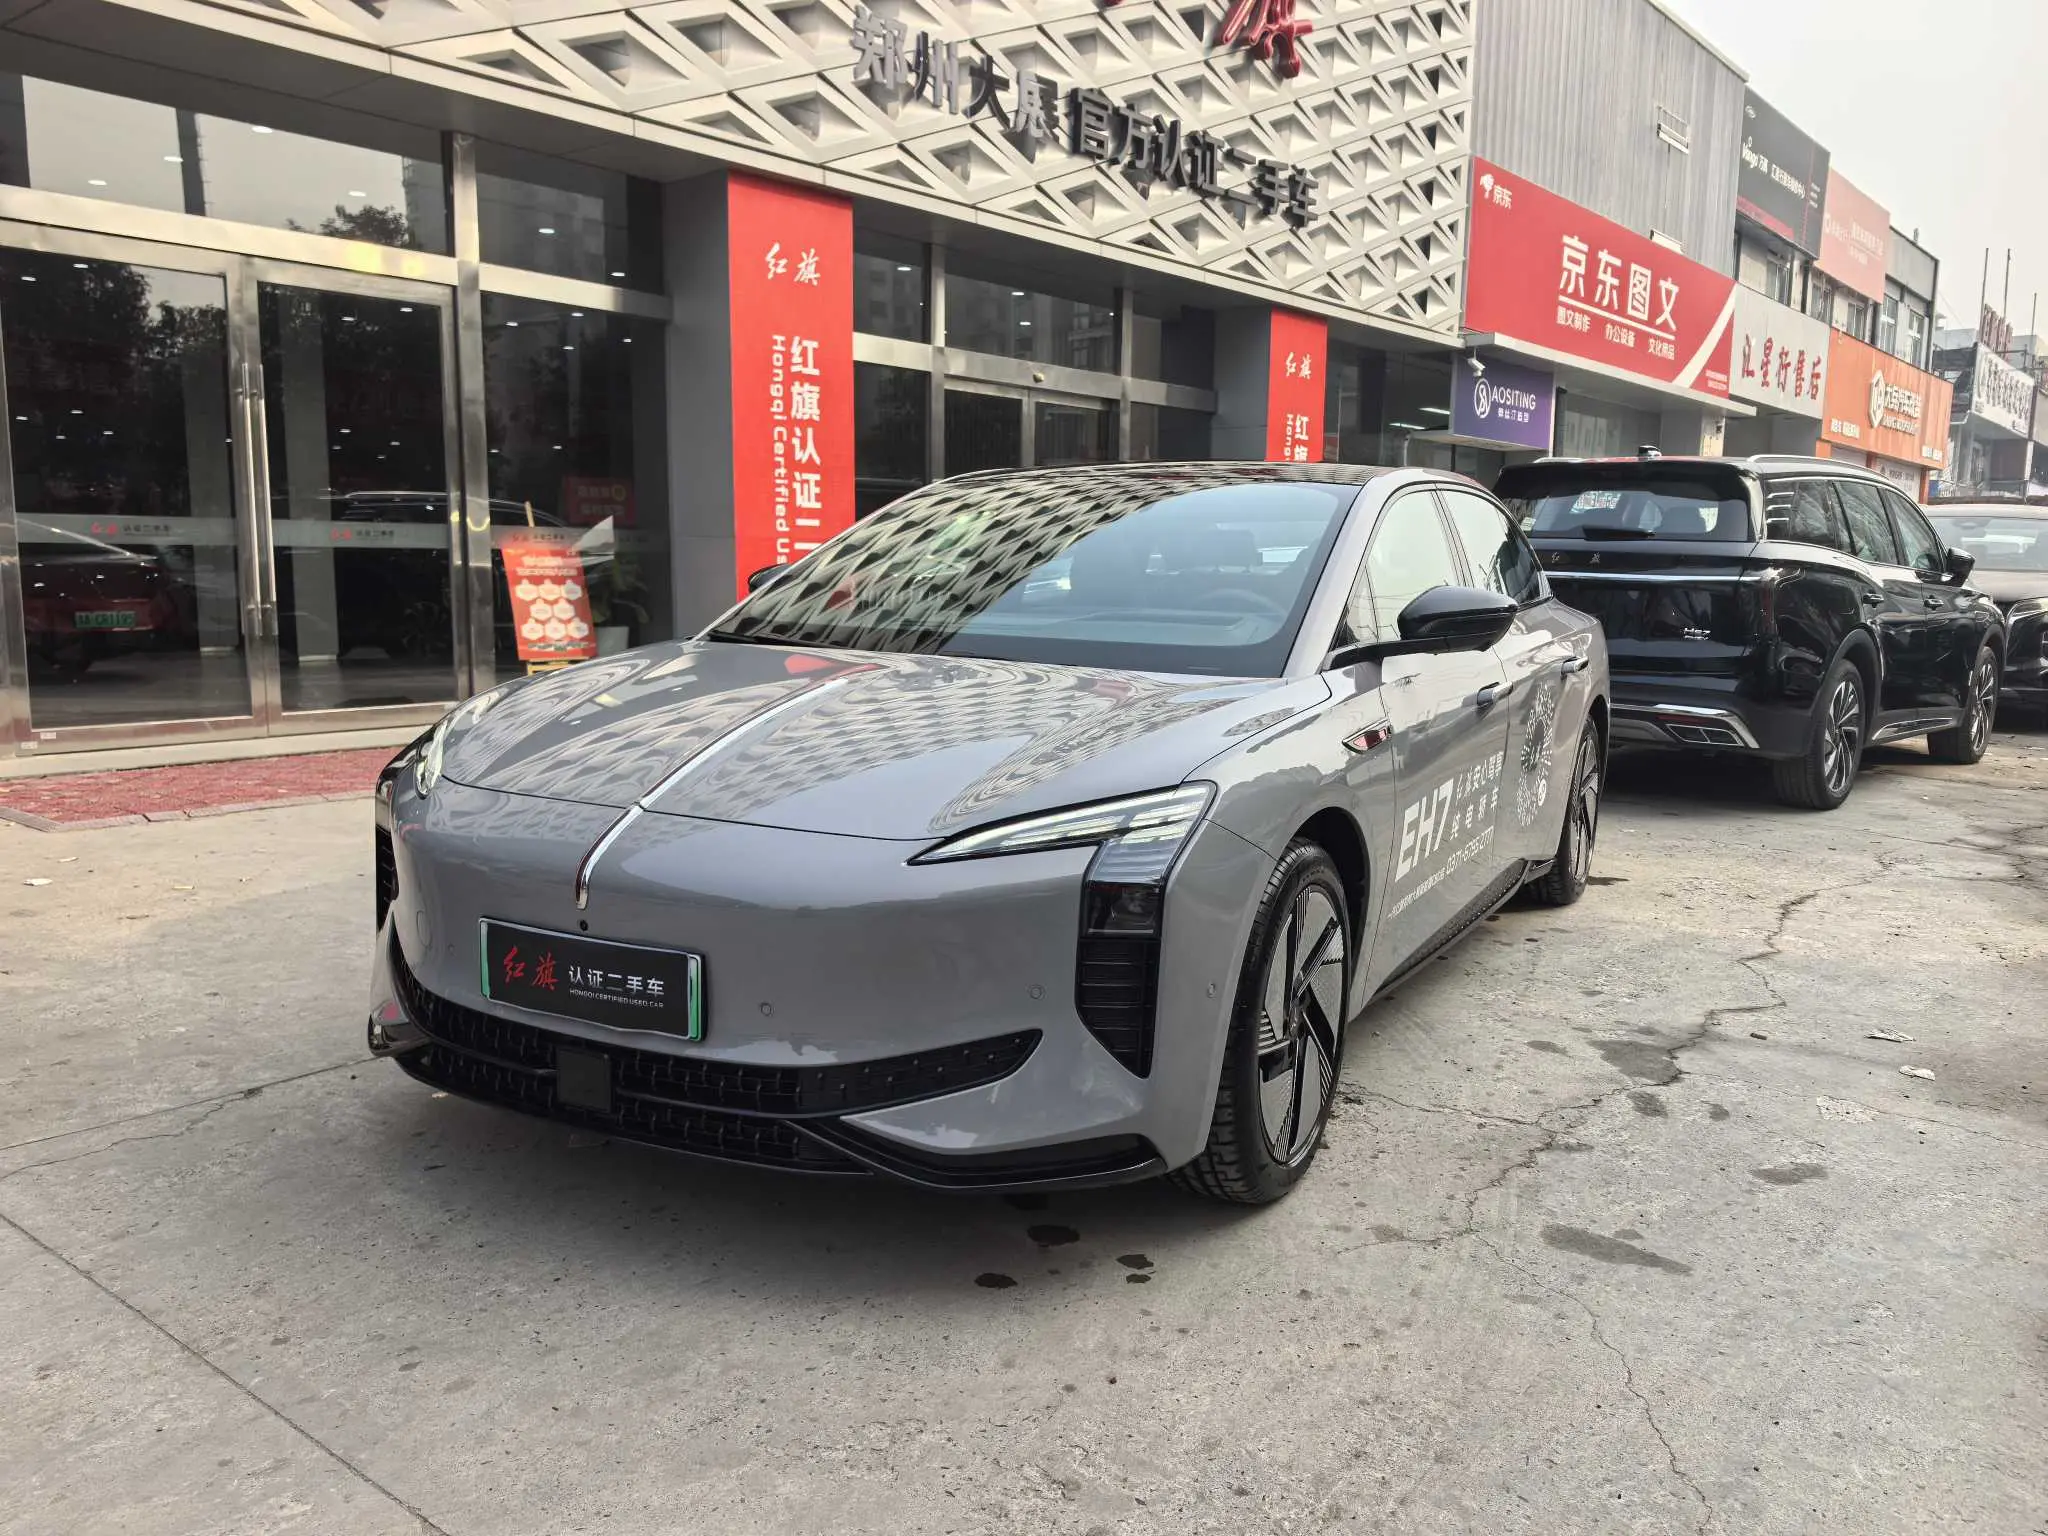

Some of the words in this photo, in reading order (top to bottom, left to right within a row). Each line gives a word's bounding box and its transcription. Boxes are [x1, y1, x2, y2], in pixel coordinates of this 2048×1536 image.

[850, 4, 1060, 145] 郑州大展
[1070, 87, 1319, 229] 官方认证二手车
[1493, 184, 1512, 209] 京东
[764, 242, 821, 287] 红旗
[1560, 235, 1680, 332] 京东图文
[1556, 305, 1592, 333] 图文制作
[1605, 323, 1636, 348] 办公设备
[1648, 338, 1676, 361] 文化用品
[770, 335, 787, 420] Hongqi
[1286, 352, 1312, 379] 红旗
[1491, 386, 1537, 411] AOSITING
[1284, 414, 1294, 462] Hong
[772, 426, 790, 532] Certified
[1395, 778, 1454, 883] EH7
[503, 944, 560, 992] 红旗
[568, 965, 665, 997] 认证二手车
[595, 993, 629, 1004] CERTIFIED
[629, 998, 648, 1007] USED
